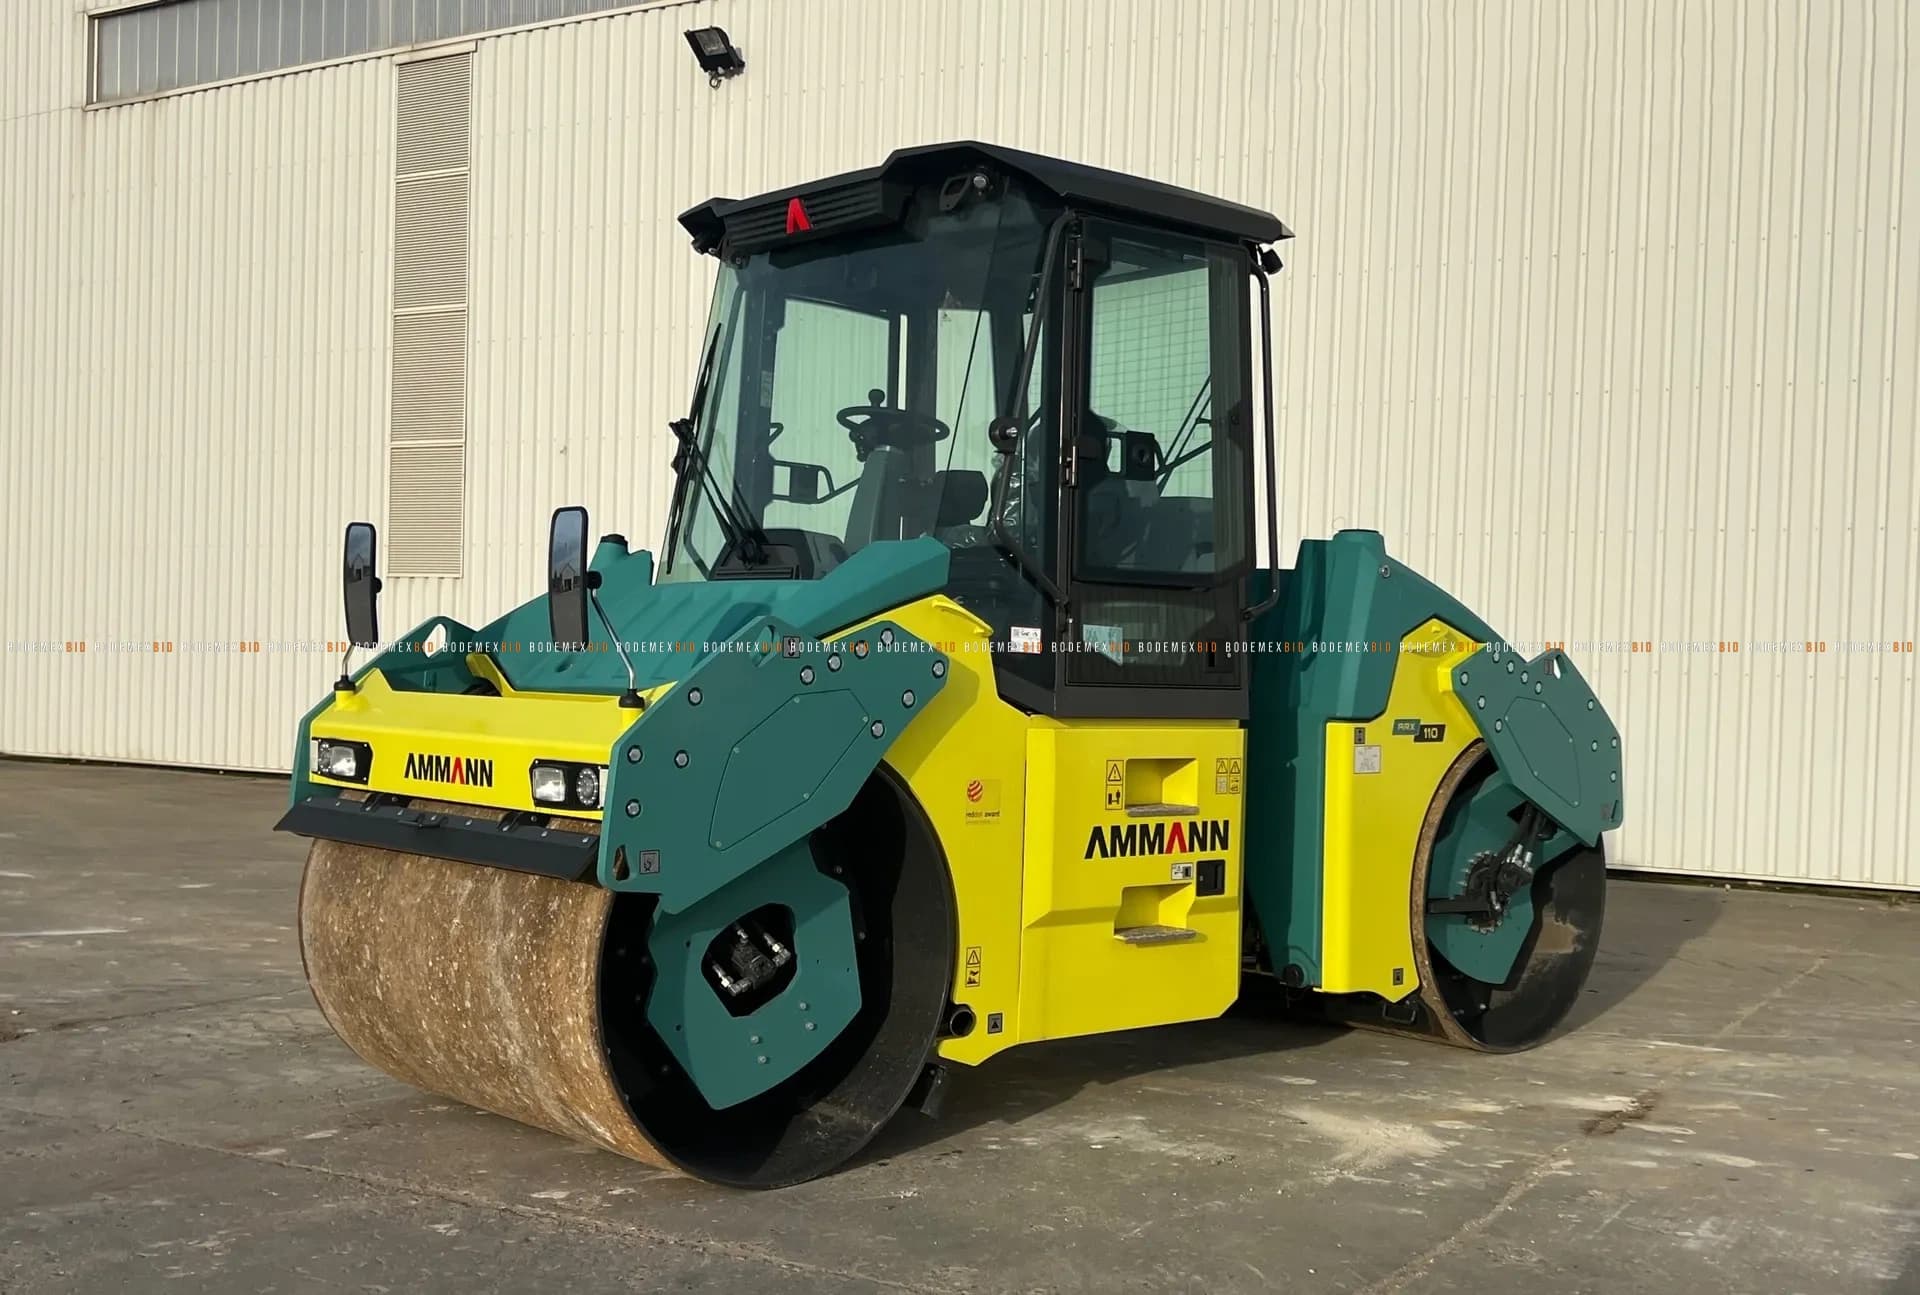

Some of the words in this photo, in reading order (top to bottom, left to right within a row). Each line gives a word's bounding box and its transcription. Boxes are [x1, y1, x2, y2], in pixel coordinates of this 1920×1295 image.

[1423, 727, 1439, 739] 110
[404, 752, 493, 788] AMMANN
[1084, 819, 1230, 860] AMMANN
